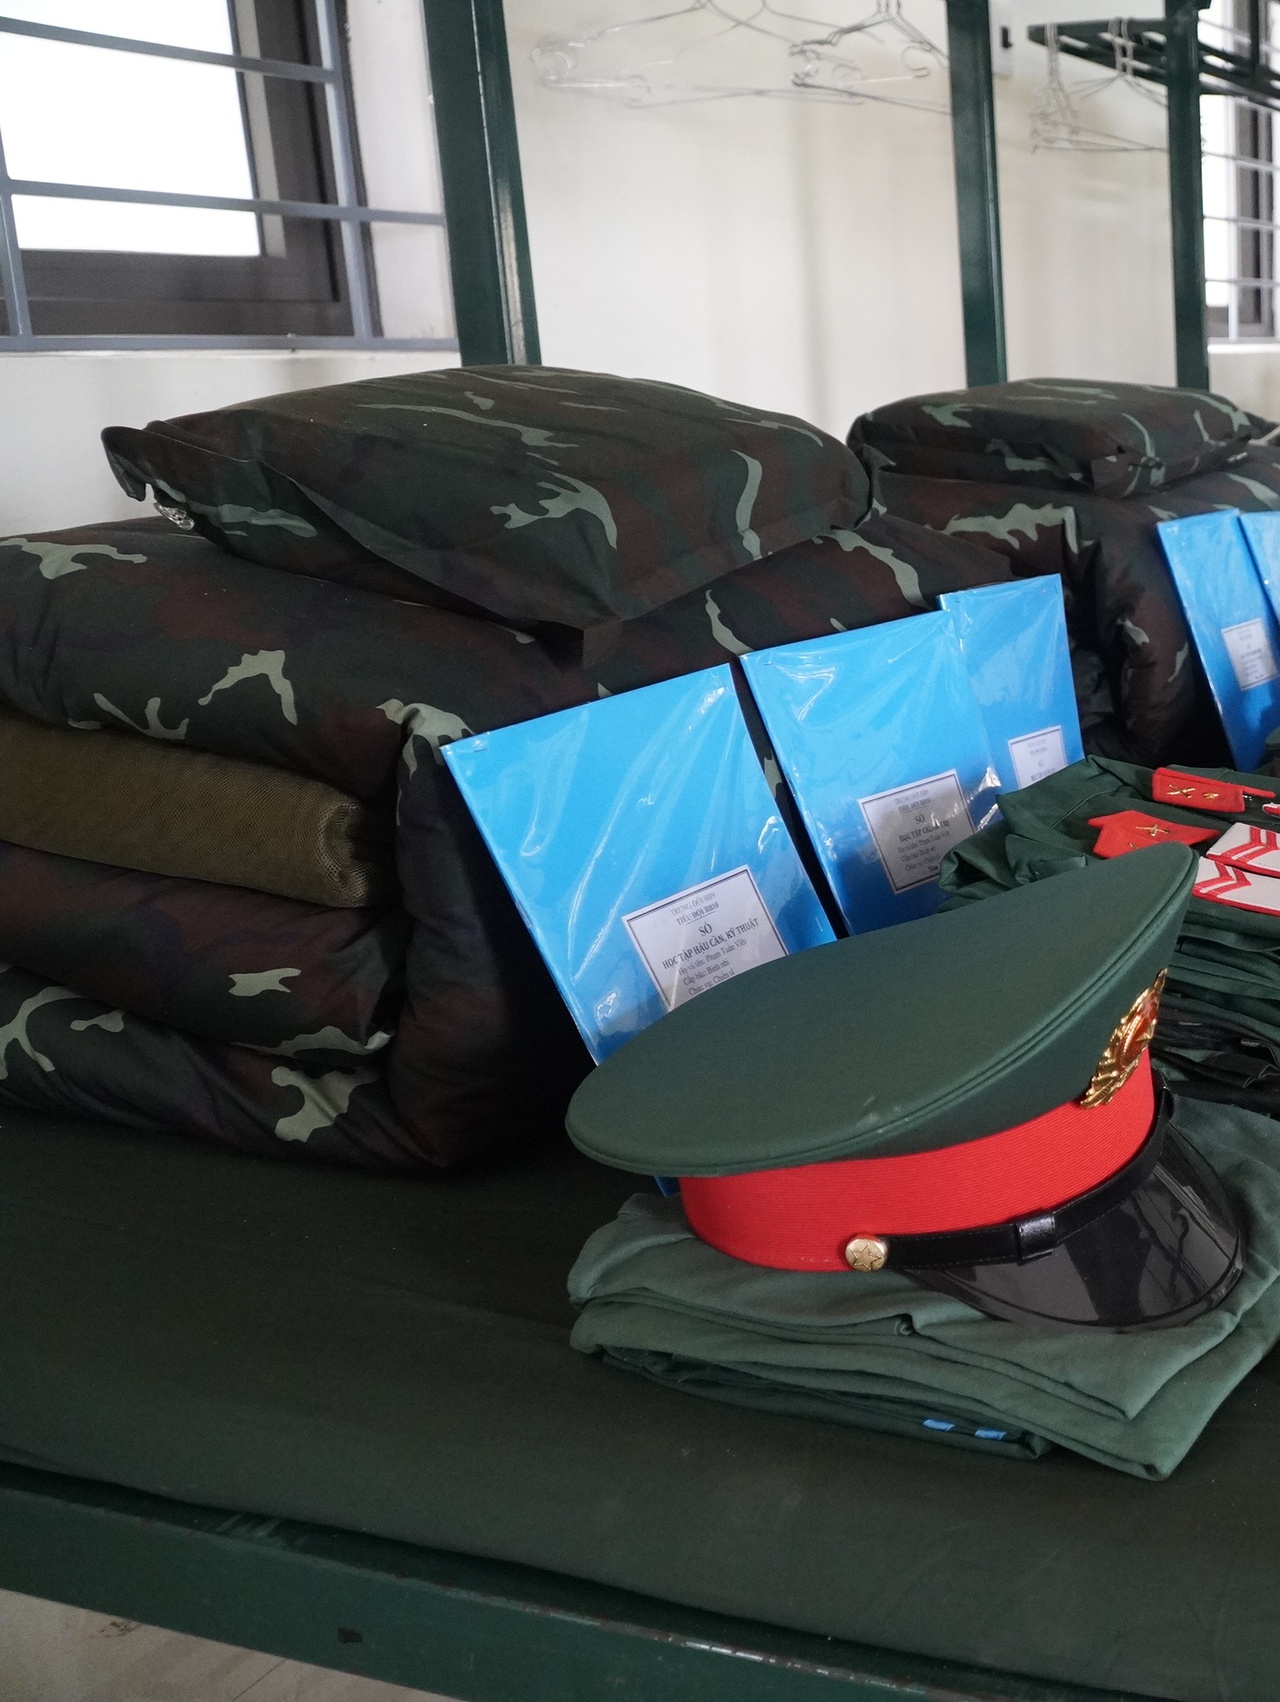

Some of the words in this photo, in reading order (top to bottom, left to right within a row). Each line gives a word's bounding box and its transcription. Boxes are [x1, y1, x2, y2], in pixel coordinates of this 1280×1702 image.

[662, 956, 680, 970] HỌC
[678, 947, 693, 962] TẬP
[692, 942, 710, 955] HẬU
[725, 927, 736, 940] KỸ
[735, 918, 759, 934] THUẬT
